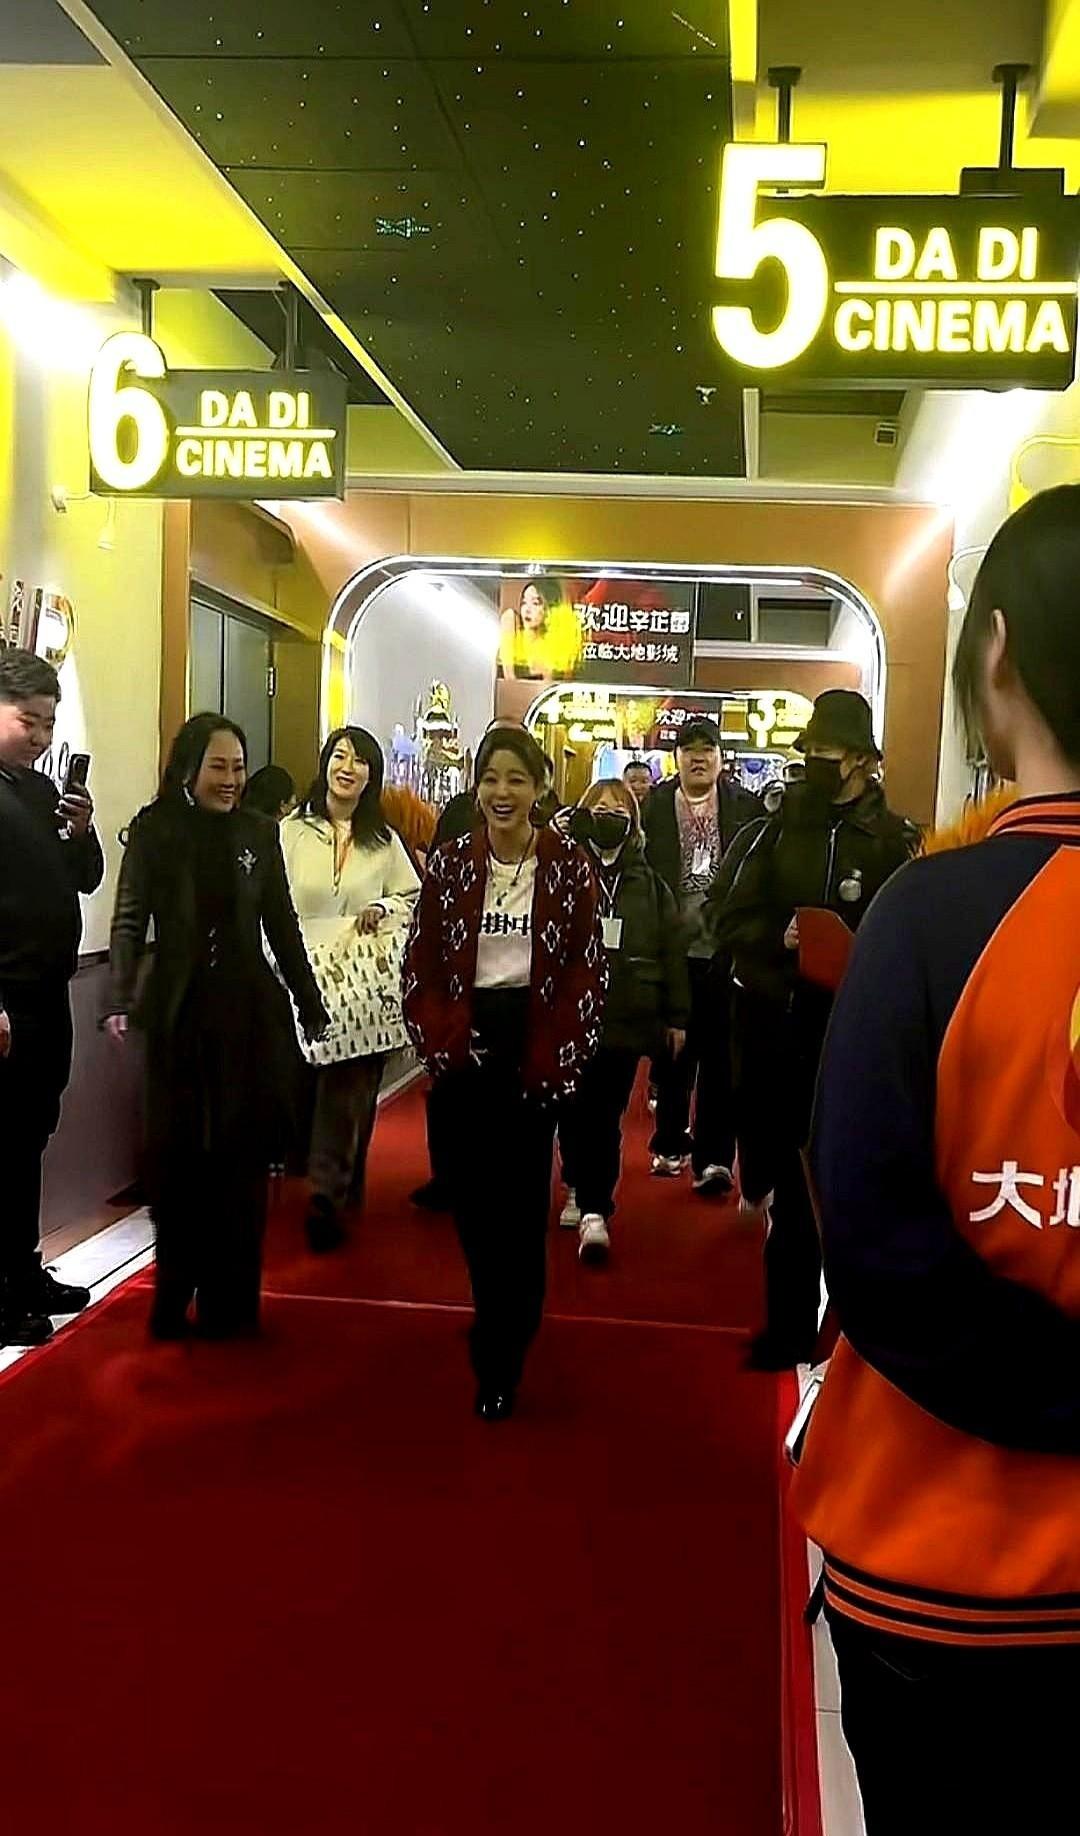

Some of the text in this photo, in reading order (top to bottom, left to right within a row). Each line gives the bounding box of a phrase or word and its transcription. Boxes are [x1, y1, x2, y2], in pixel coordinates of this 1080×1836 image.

[712, 142, 828, 369] 5
[874, 226, 1039, 280] DA DI
[833, 298, 1070, 352] CINEMA
[88, 331, 169, 490] 6
[200, 389, 310, 428] DA DI
[174, 438, 333, 478] CINEMA
